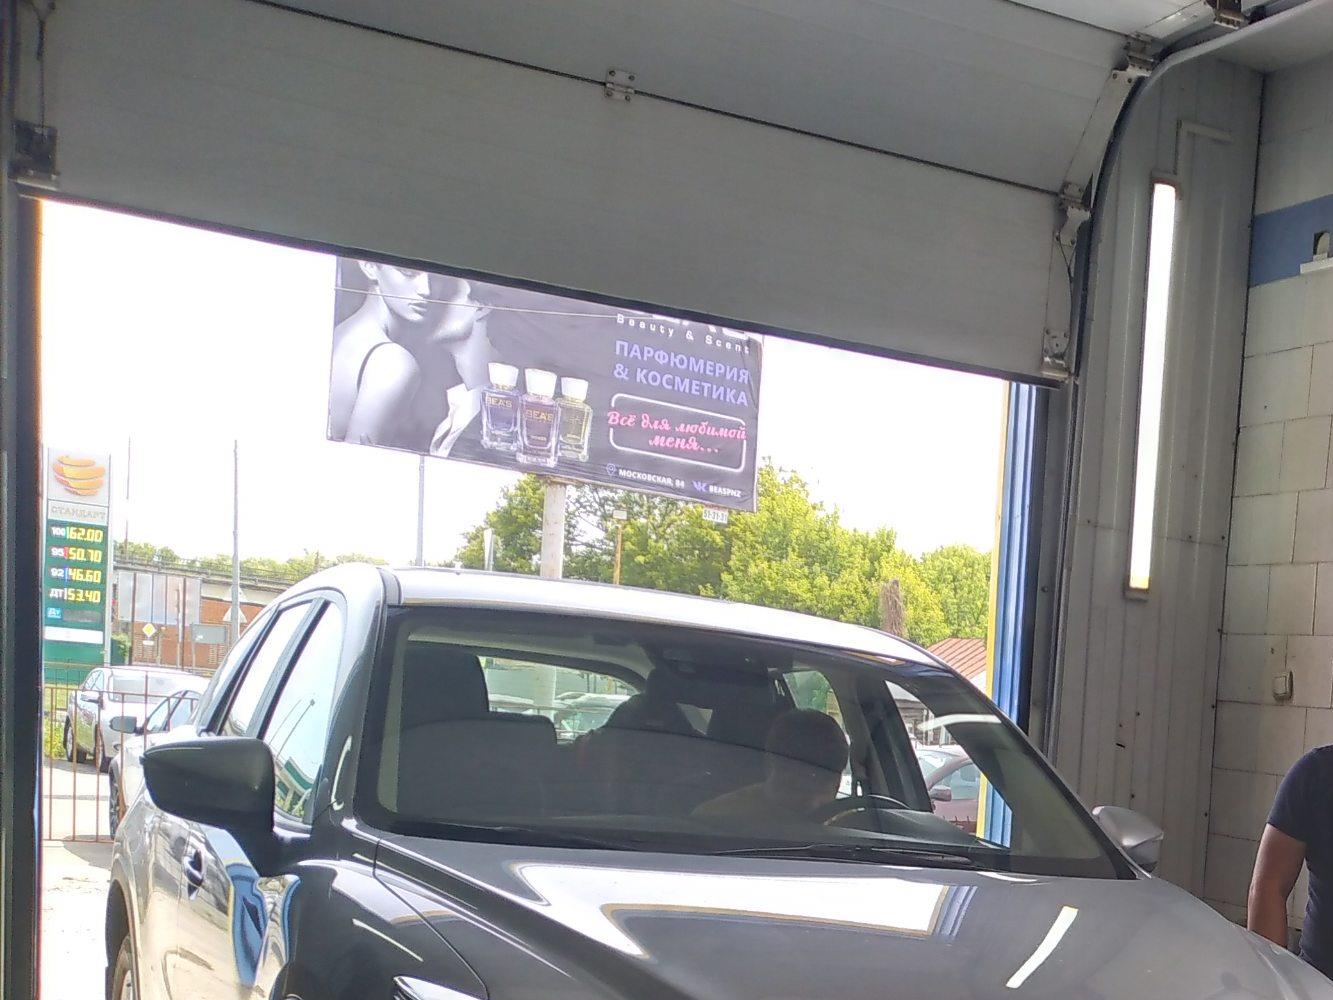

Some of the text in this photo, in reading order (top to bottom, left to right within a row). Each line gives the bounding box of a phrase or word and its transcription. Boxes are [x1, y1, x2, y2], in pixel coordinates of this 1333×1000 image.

[616, 313, 674, 338] Beauty
[685, 330, 695, 341] &
[705, 334, 749, 354] Scent
[615, 340, 749, 385] ПАРФЮМЕРИЯ
[613, 363, 748, 407] & КОСМЕТИКА
[607, 410, 747, 440] Всё для любимой
[708, 484, 742, 498] BEASPNZ
